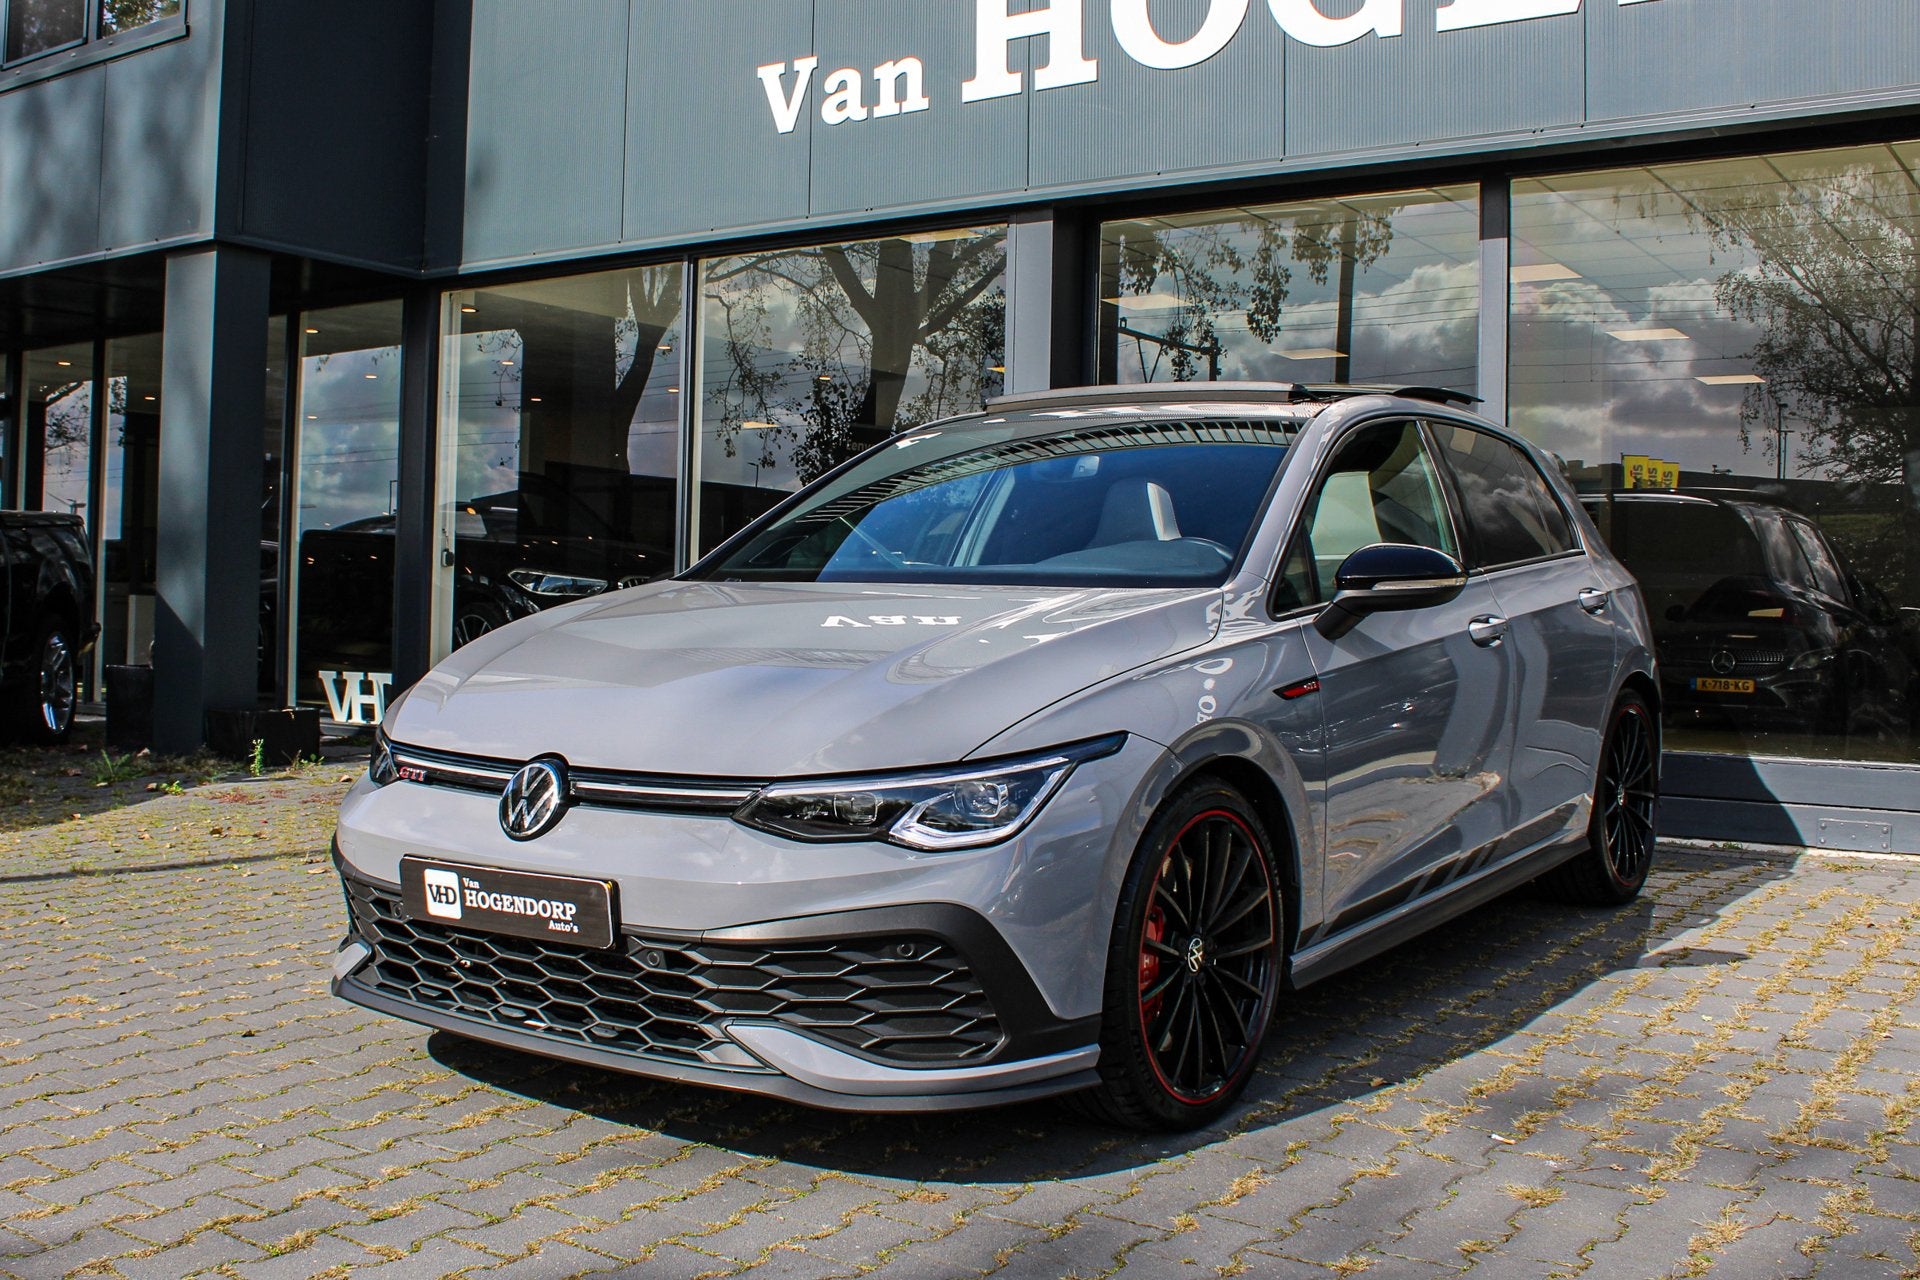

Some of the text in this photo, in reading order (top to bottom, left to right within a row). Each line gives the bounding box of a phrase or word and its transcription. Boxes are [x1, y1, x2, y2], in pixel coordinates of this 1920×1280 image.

[757, 56, 930, 134] Van
[400, 766, 426, 781] GTI
[462, 877, 480, 889] Van
[427, 884, 457, 905] VHD
[464, 889, 577, 921] HOGENDORP
[548, 920, 579, 933] Auto's
